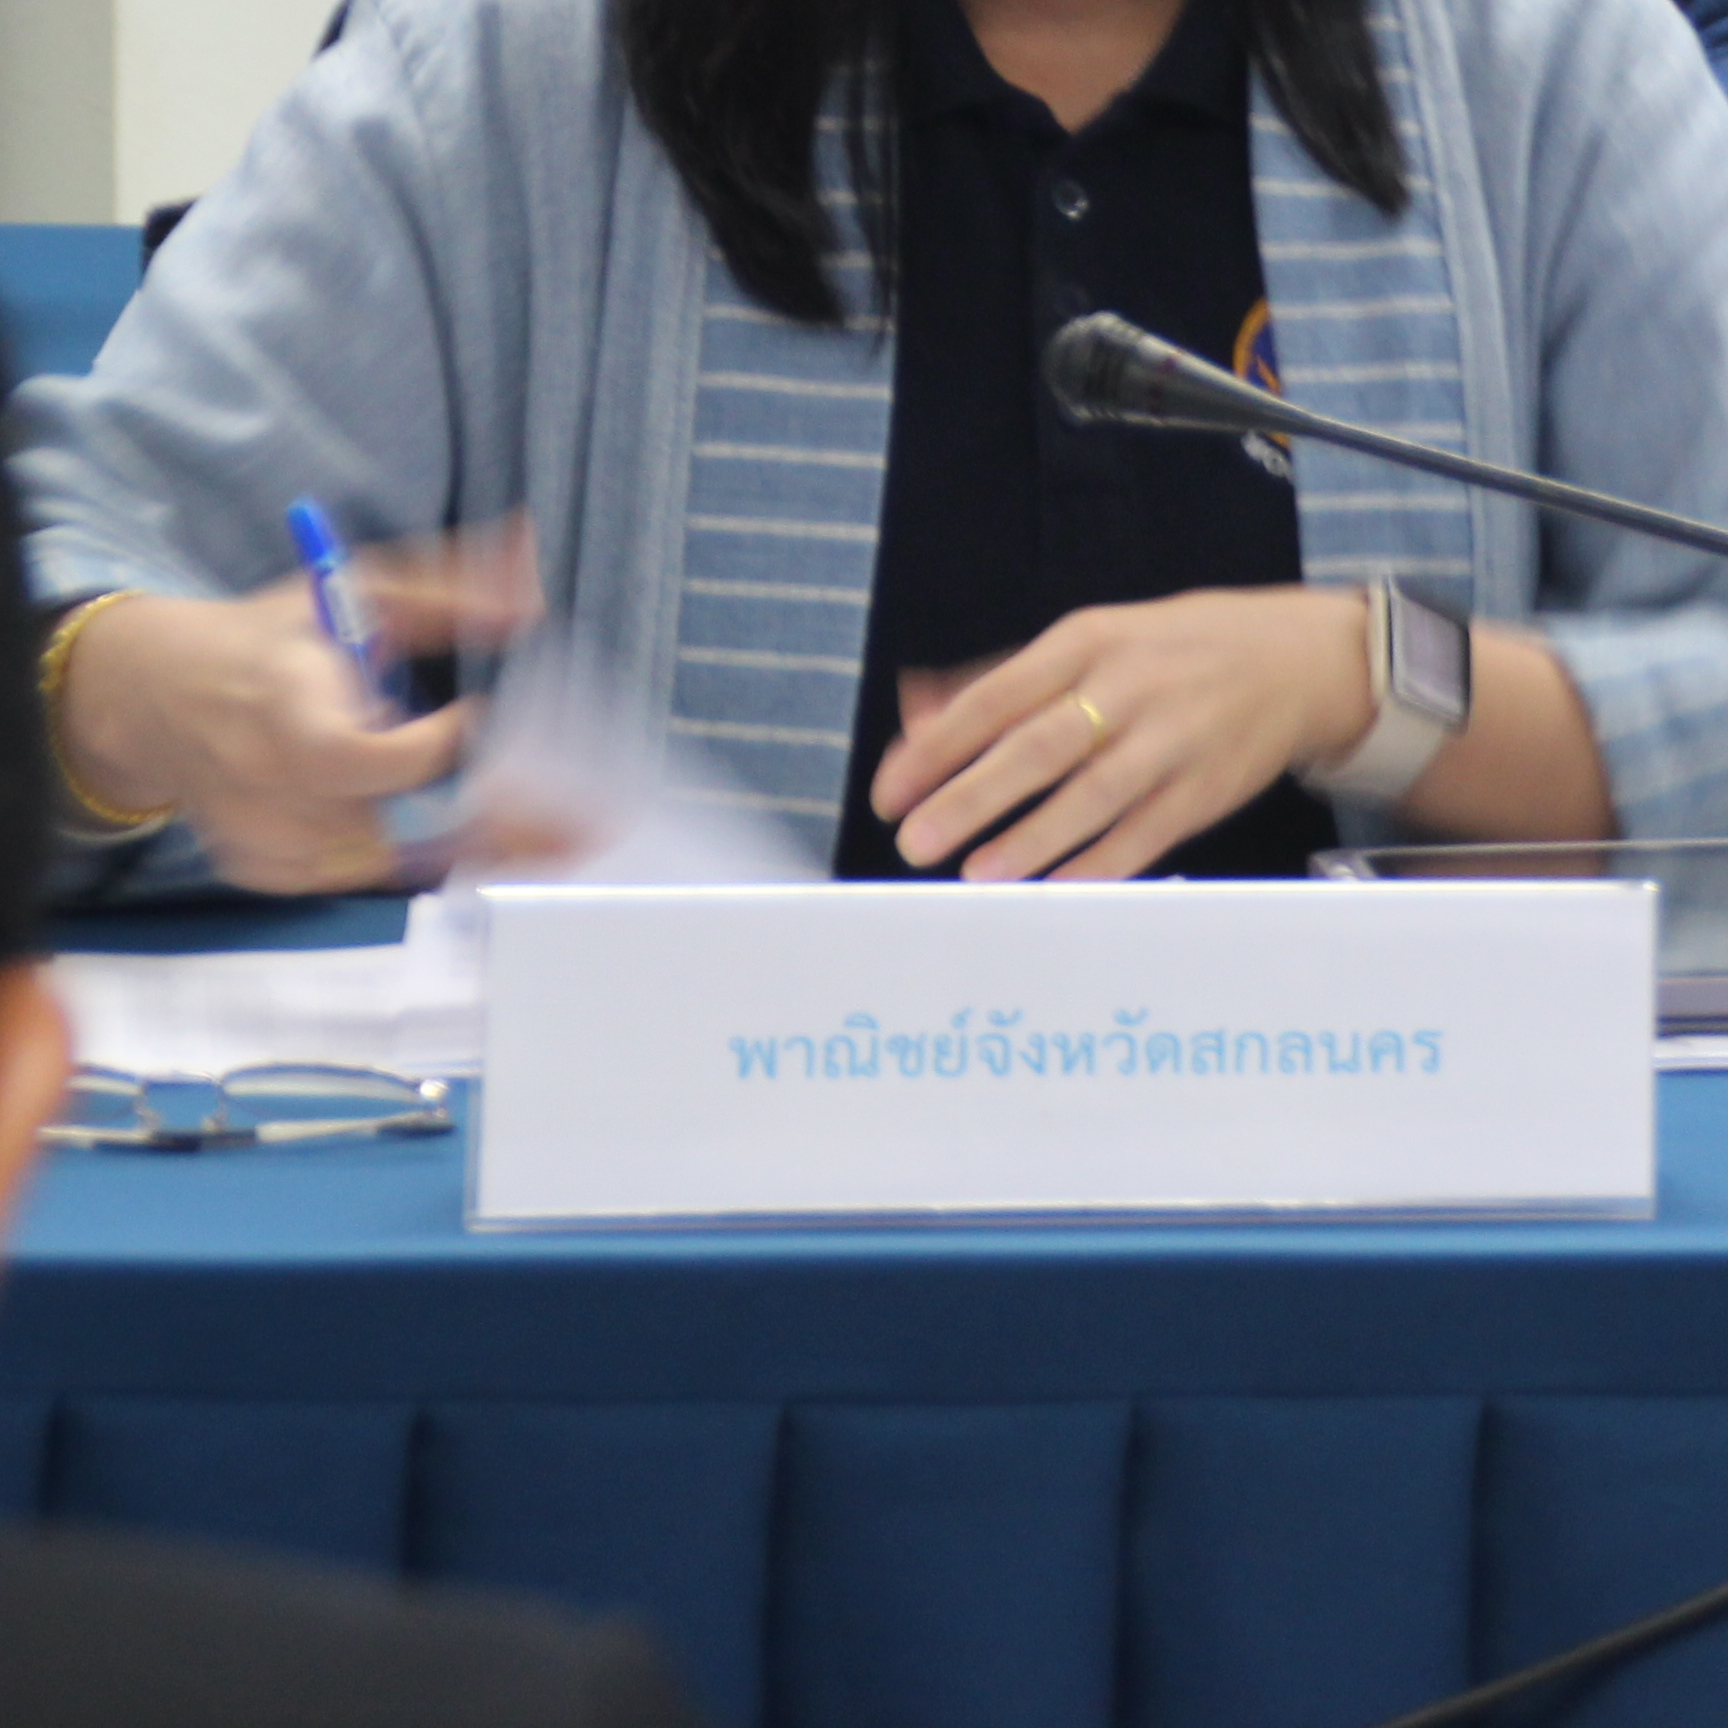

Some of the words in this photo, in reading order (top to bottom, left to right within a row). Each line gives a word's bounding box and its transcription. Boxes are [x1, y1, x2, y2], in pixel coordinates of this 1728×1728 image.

[729, 1008, 1442, 1078] พาณิชย์จังหวัดสกลนคร
